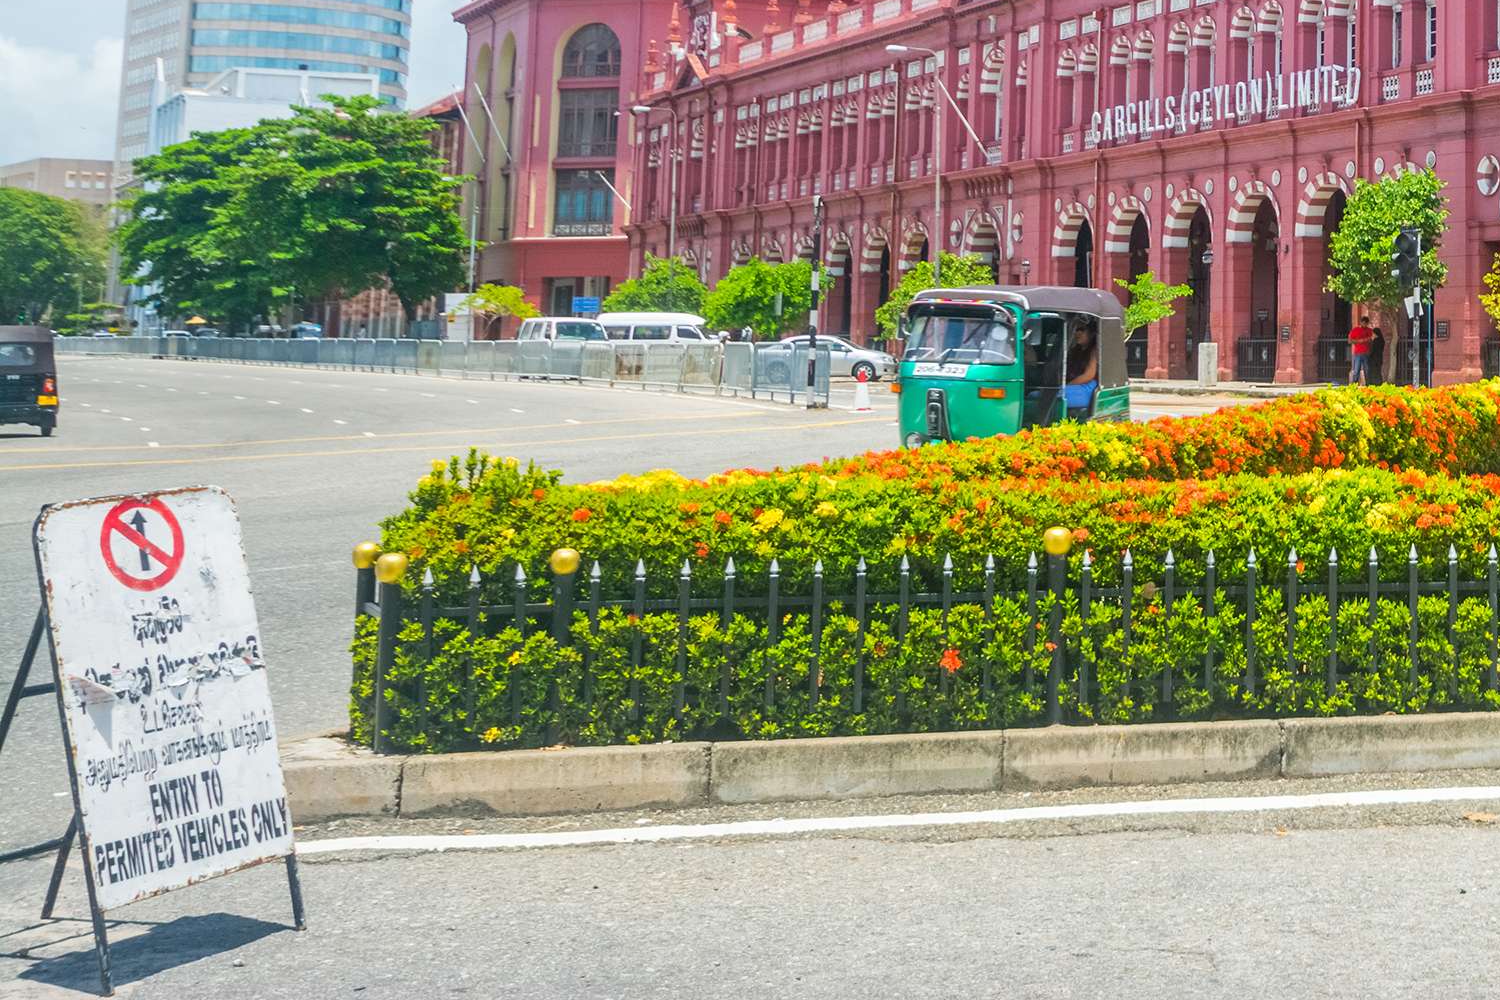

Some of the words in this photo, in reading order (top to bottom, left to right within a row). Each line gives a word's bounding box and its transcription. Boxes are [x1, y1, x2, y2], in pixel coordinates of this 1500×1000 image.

[1091, 95, 1175, 143] CARGILLS
[1180, 71, 1272, 132] (CEYLON)
[1277, 64, 1361, 109] LIMITED
[149, 774, 199, 824] ENTRY
[201, 769, 223, 809] TO
[95, 827, 175, 887] PERMITED
[175, 807, 250, 863] VEHICLES
[251, 797, 288, 843] ONLY
